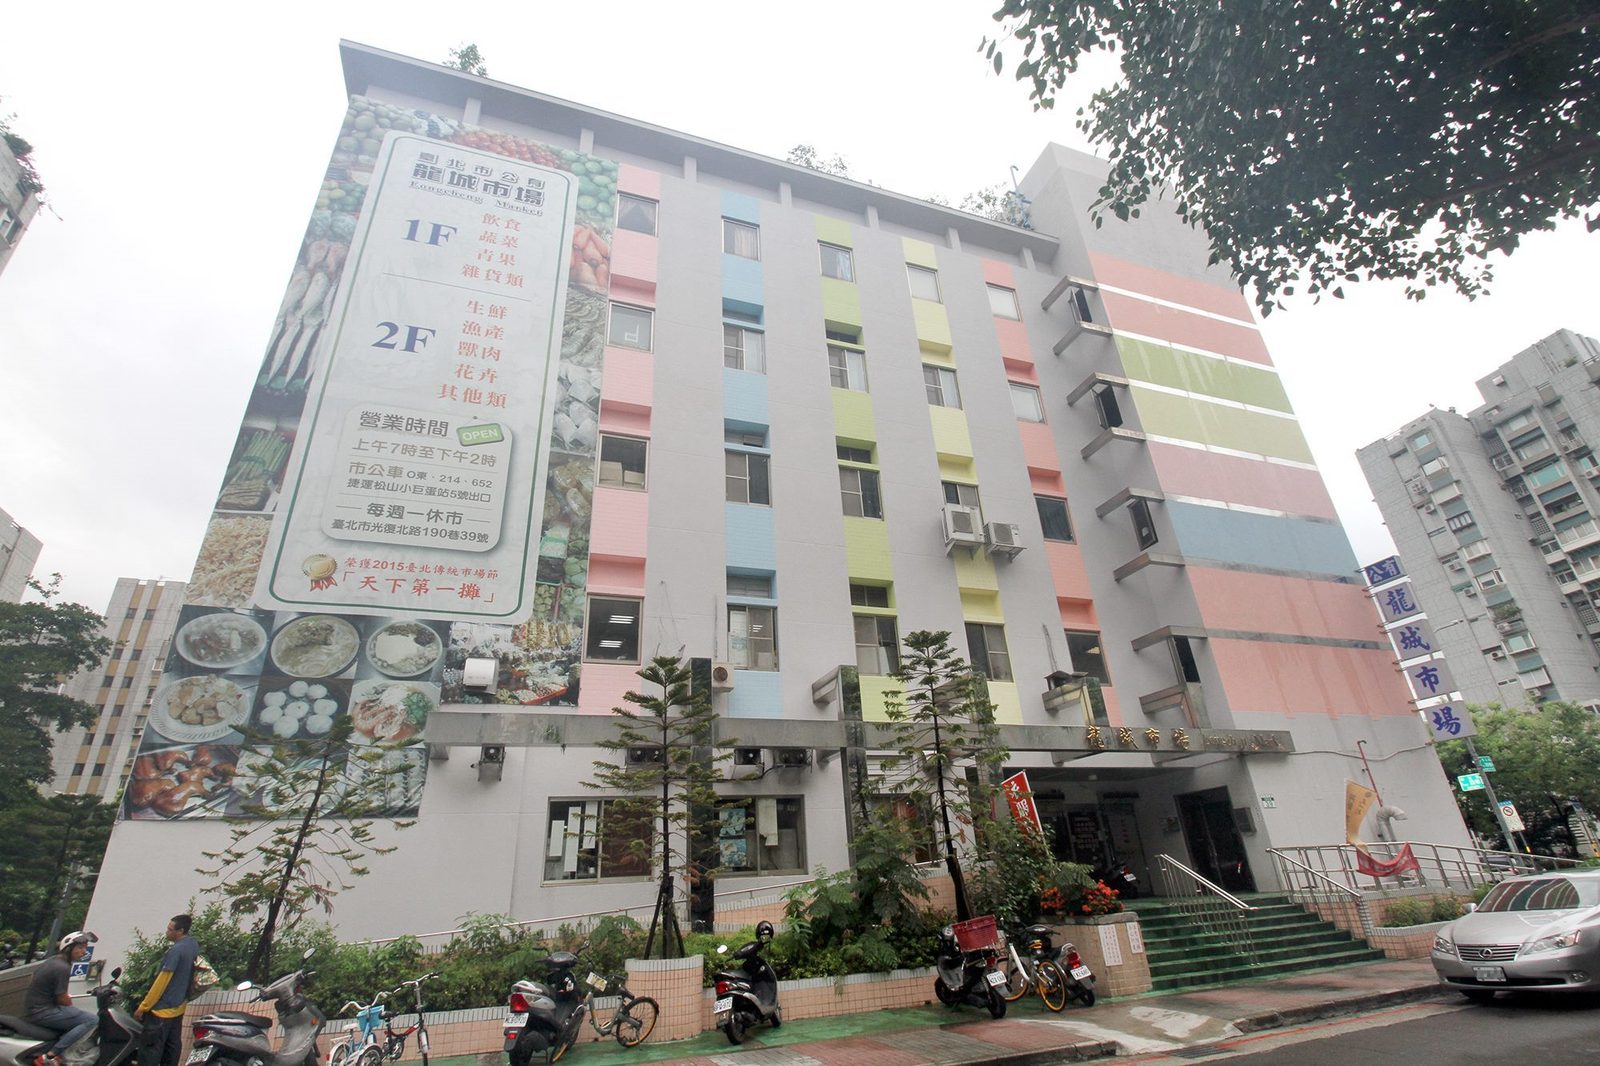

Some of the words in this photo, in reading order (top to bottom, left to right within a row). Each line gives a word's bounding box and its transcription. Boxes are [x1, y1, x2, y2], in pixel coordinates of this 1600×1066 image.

[411, 162, 545, 207] 龍城市場
[401, 219, 458, 247] 1F
[482, 213, 520, 231] 飲食
[479, 230, 518, 248] 蔬菜
[477, 248, 516, 266] 青果
[461, 263, 524, 288] 雜貨類
[465, 300, 507, 320] 生鮮
[371, 321, 437, 353] 2F
[462, 320, 504, 340] 漁產
[458, 340, 502, 361] 獸肉
[455, 363, 498, 383] 花卉
[437, 383, 507, 408] 其他類
[359, 410, 449, 437] 營業時間
[462, 428, 498, 442] OPEN
[352, 438, 497, 468] 上午7時至下午2時
[348, 461, 404, 479] 市公車
[346, 477, 492, 503] 捷運松山小巨蛋站5號出口
[366, 502, 464, 525] 每週一休市
[1366, 555, 1400, 583] 公有
[1384, 587, 1461, 736] 龍城市場
